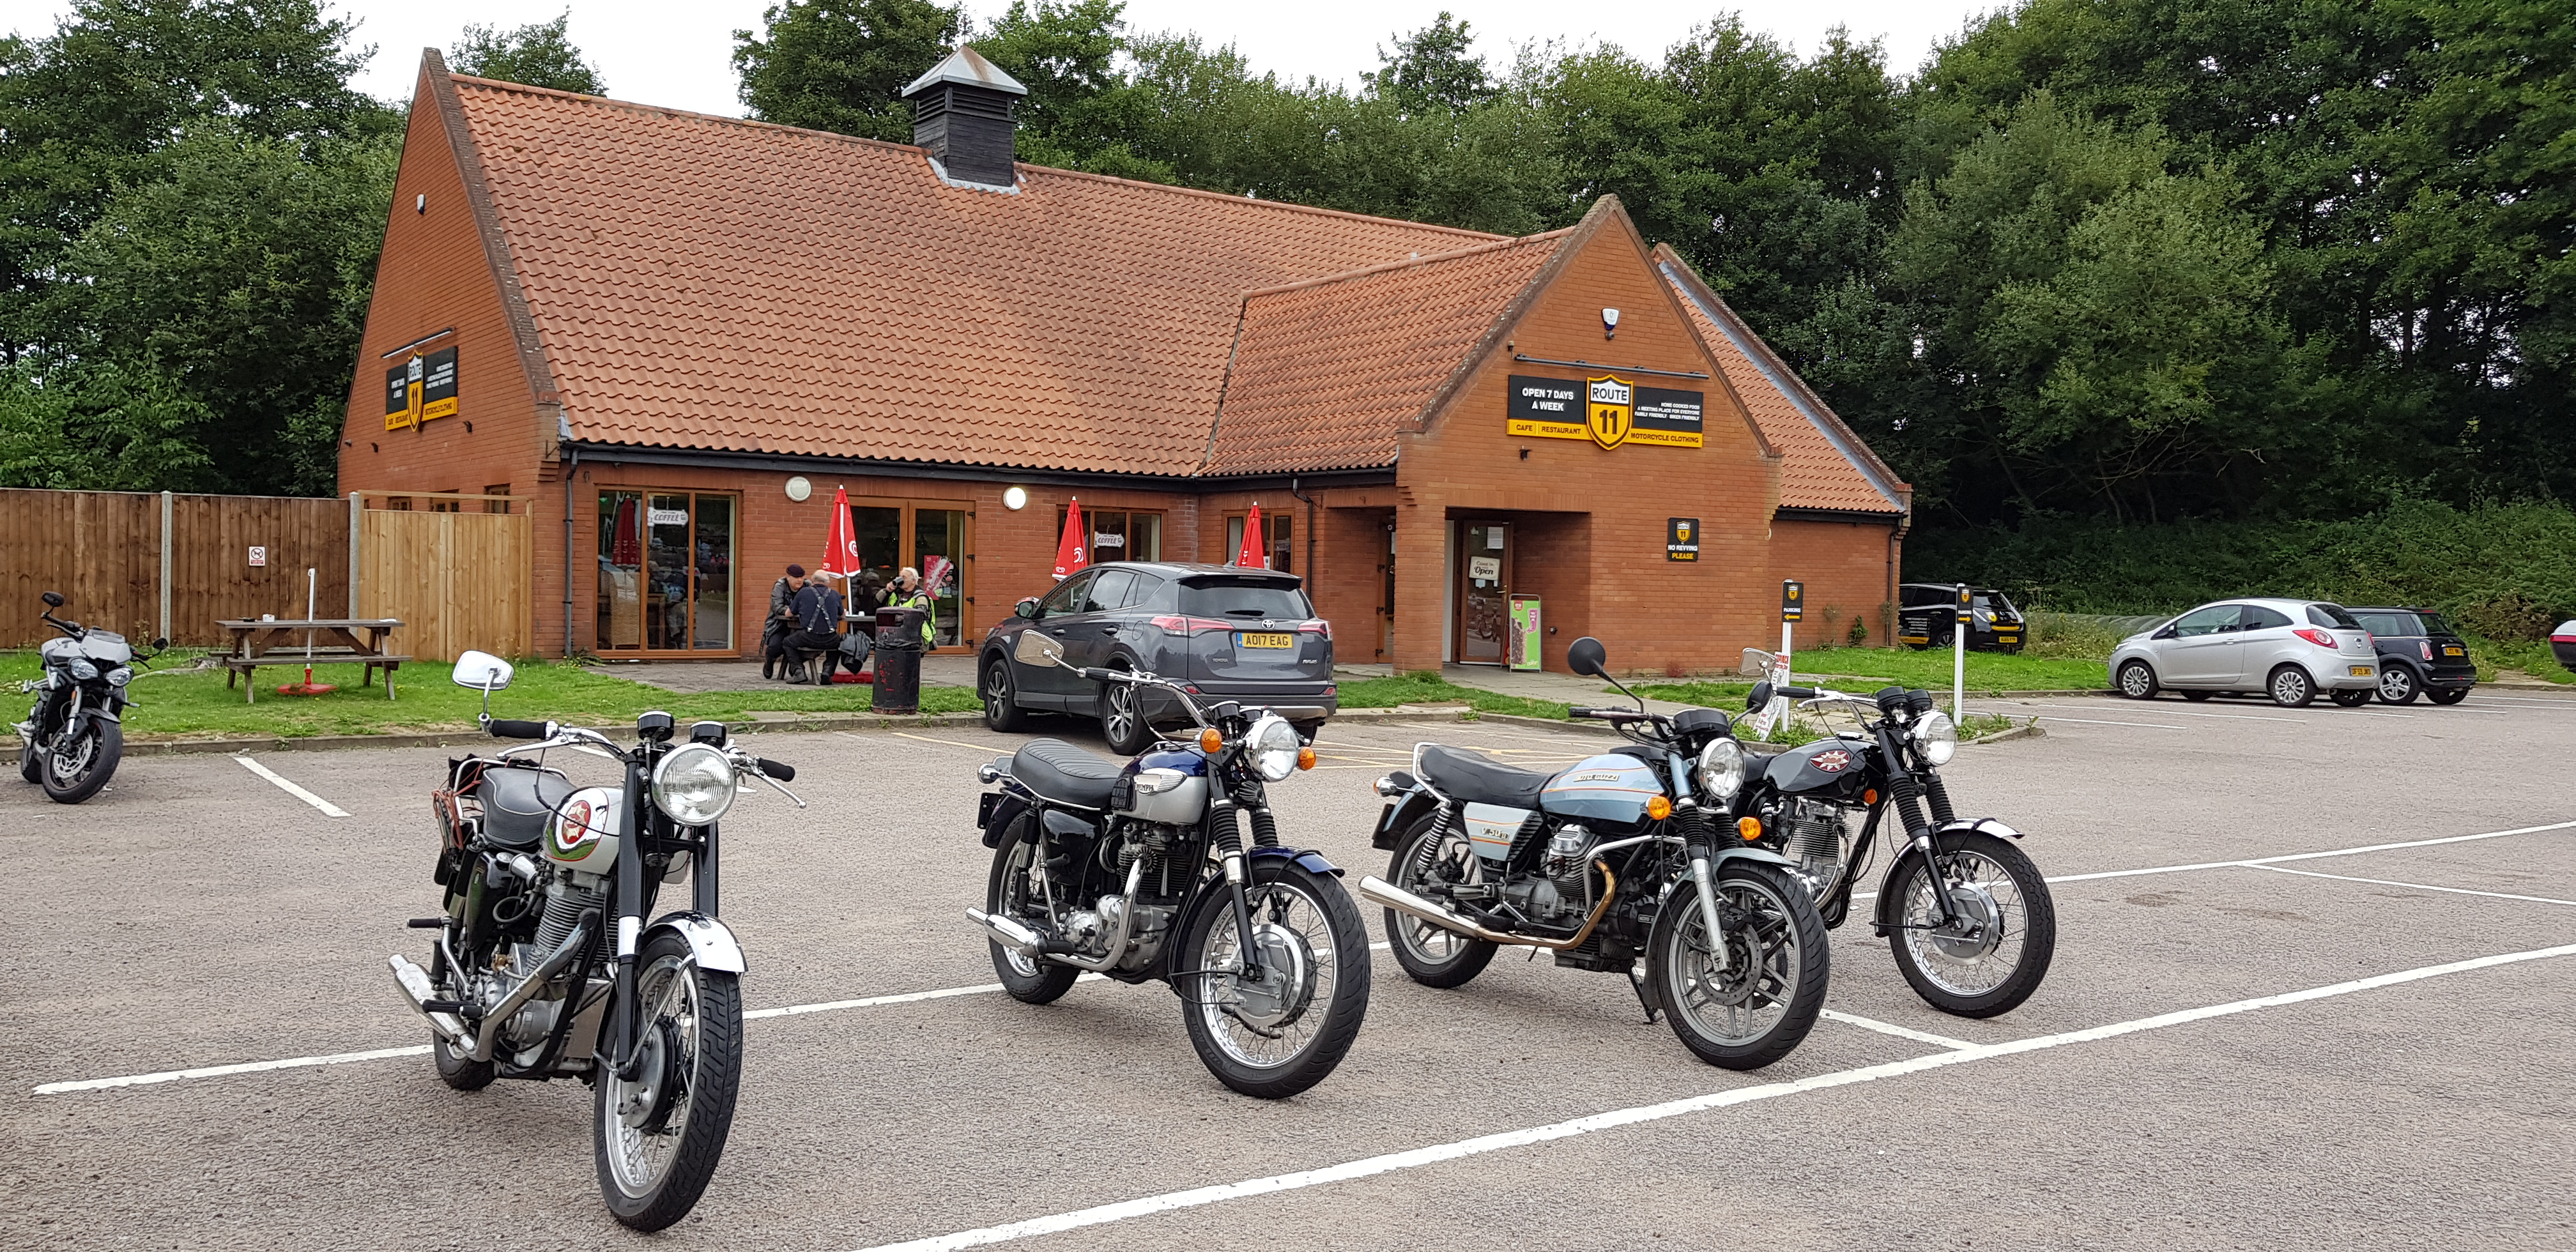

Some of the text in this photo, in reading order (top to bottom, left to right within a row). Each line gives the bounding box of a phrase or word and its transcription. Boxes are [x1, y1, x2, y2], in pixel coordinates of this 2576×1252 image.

[1522, 387, 1574, 401] OPEN 7 DAYS
[1592, 387, 1627, 401] ROUTE
[1531, 401, 1564, 411] A WEEK
[1598, 409, 1618, 434] 11
[1542, 426, 1581, 434] RESTAURANT
[1630, 432, 1669, 441] MOTORCYCLE
[654, 513, 679, 521] COFFEE
[1474, 566, 1494, 576] Open
[1269, 636, 1289, 646] EAG
[1595, 774, 1620, 782] GUZZI
